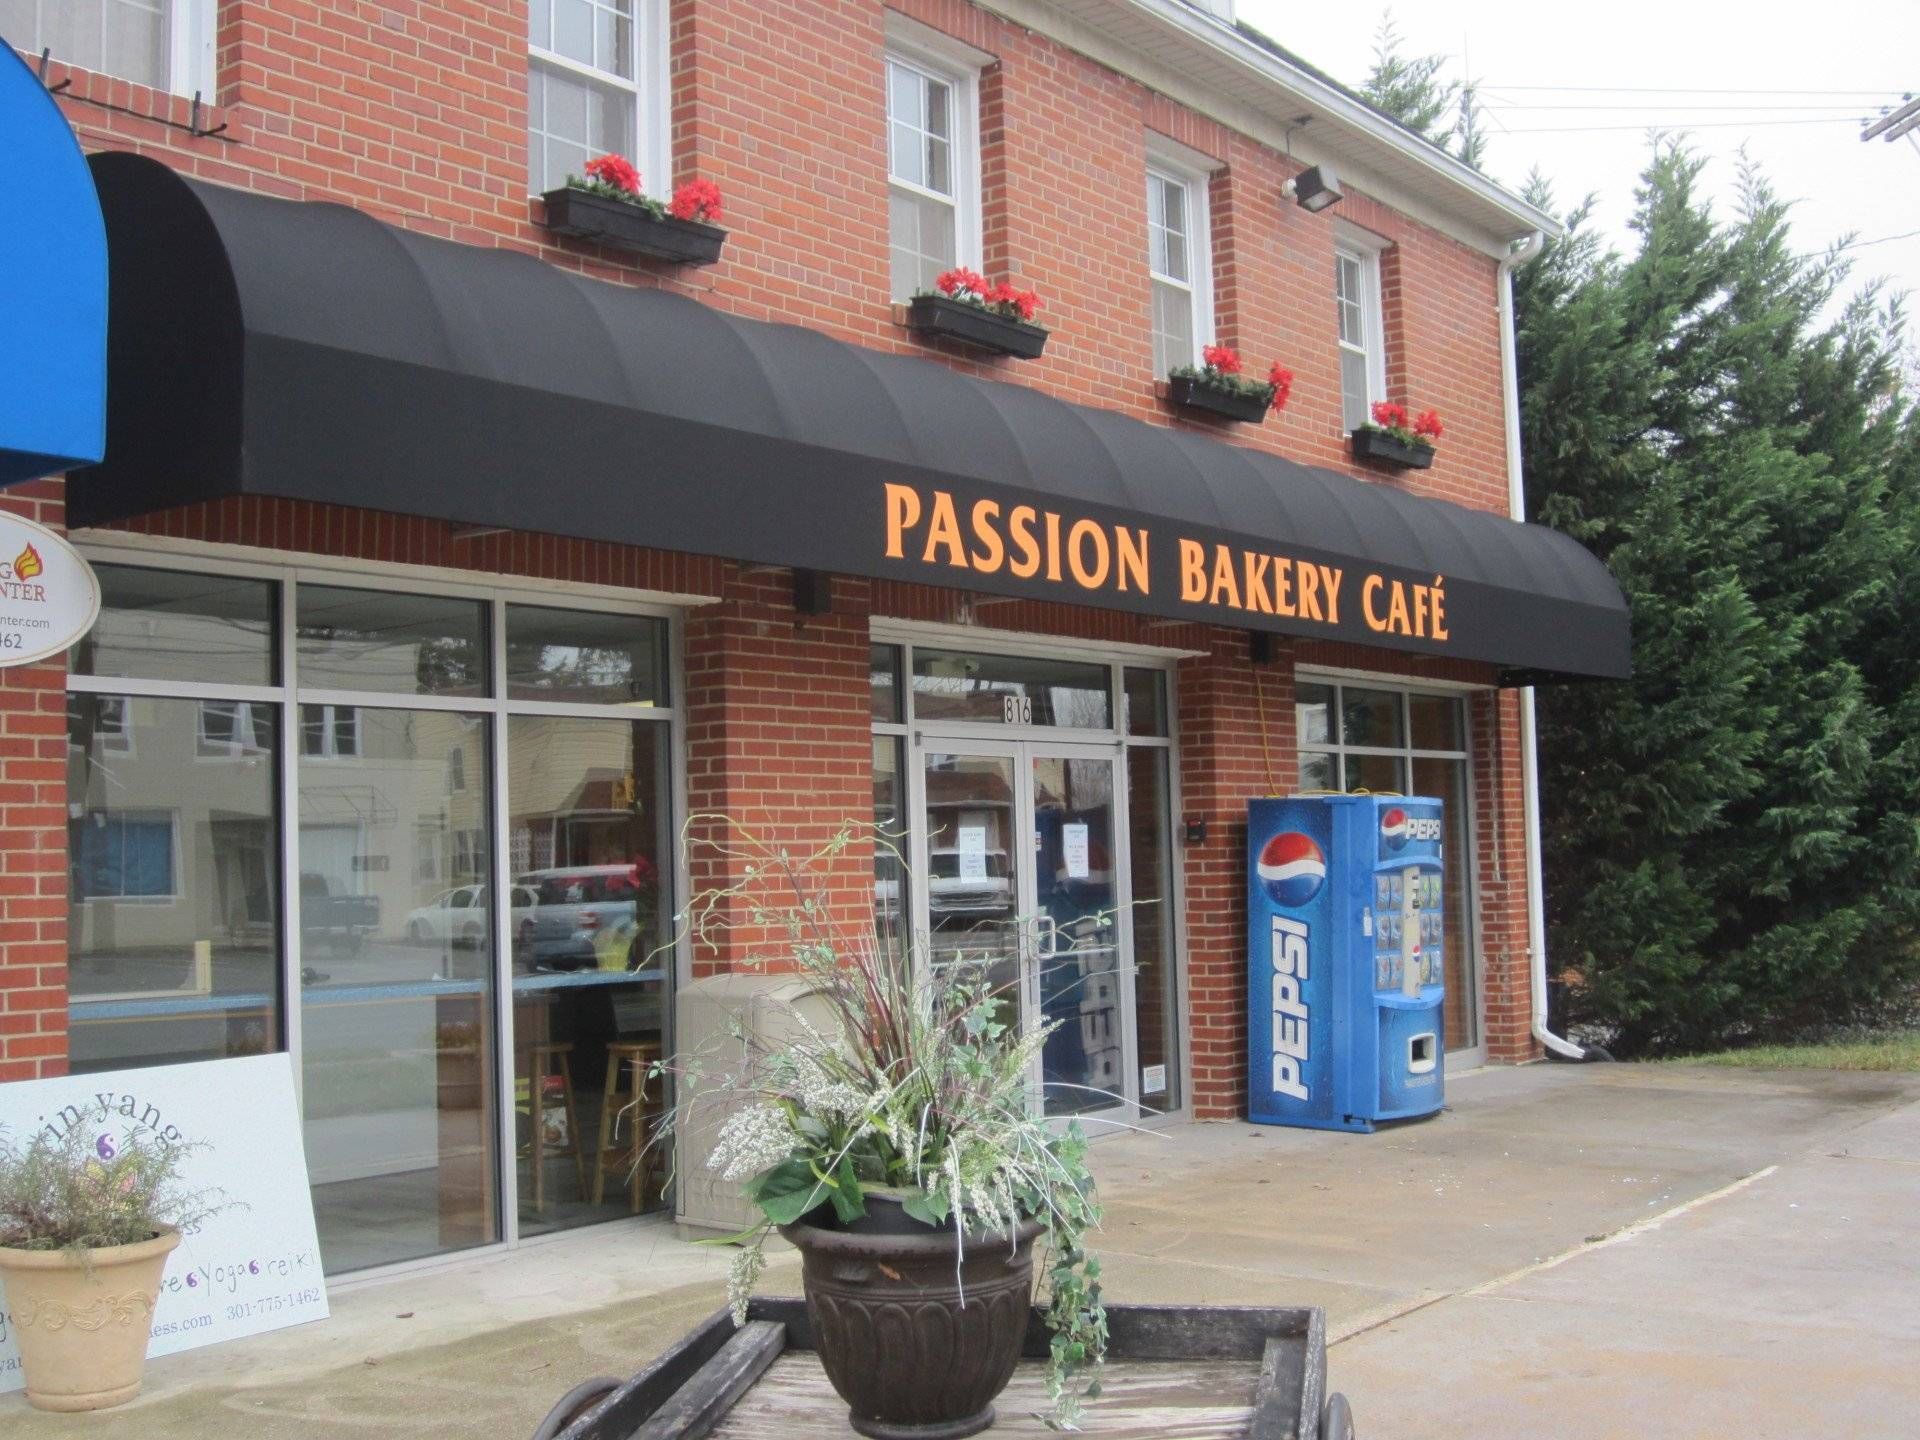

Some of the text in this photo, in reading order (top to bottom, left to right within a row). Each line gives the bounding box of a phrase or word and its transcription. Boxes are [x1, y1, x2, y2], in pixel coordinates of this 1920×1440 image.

[884, 483, 1448, 641] PASSION BAKERY CAFÉ
[1006, 698, 1031, 723] 816
[1272, 915, 1309, 1101] PEPSI
[38, 1092, 183, 1151] in yang
[149, 1286, 321, 1338] ess.com 301-775-1462
